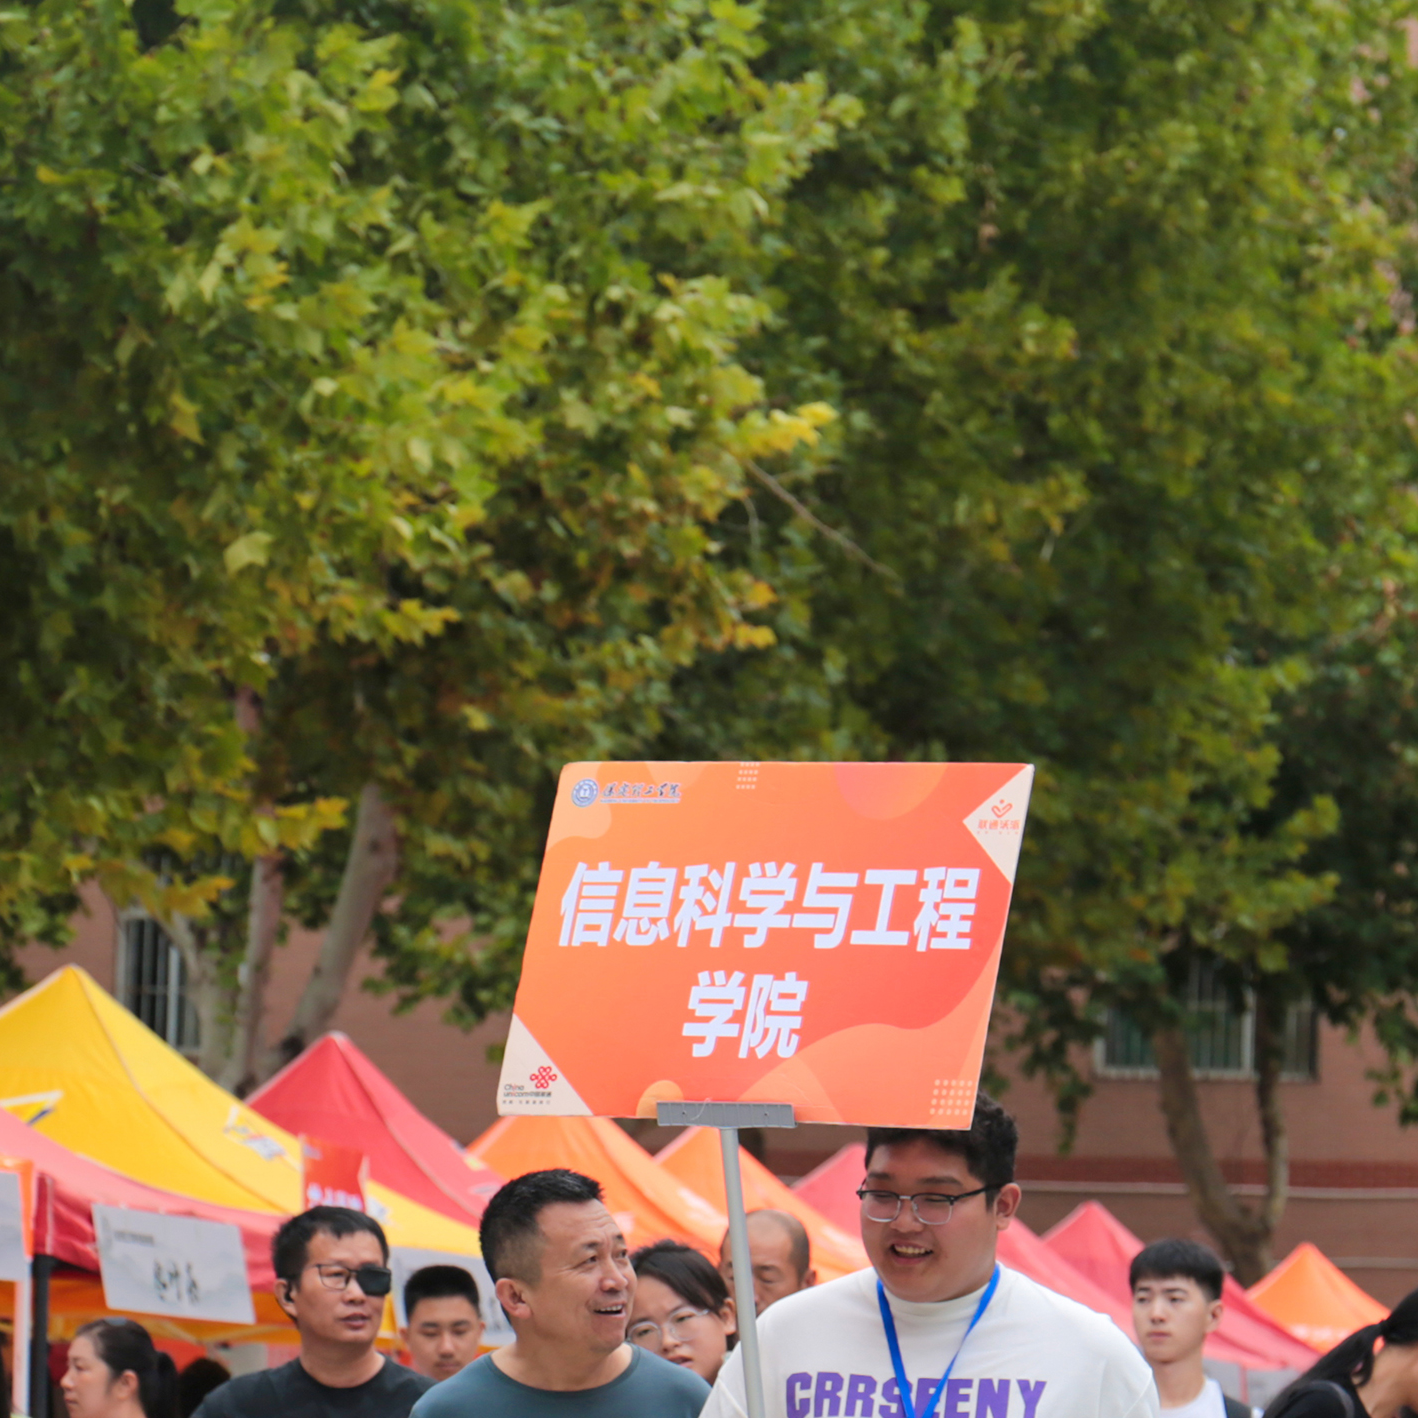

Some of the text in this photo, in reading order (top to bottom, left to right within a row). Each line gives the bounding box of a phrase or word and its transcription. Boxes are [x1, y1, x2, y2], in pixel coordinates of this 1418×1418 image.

[558, 861, 981, 952] 信息科学与工程
[682, 970, 808, 1059] 学院
